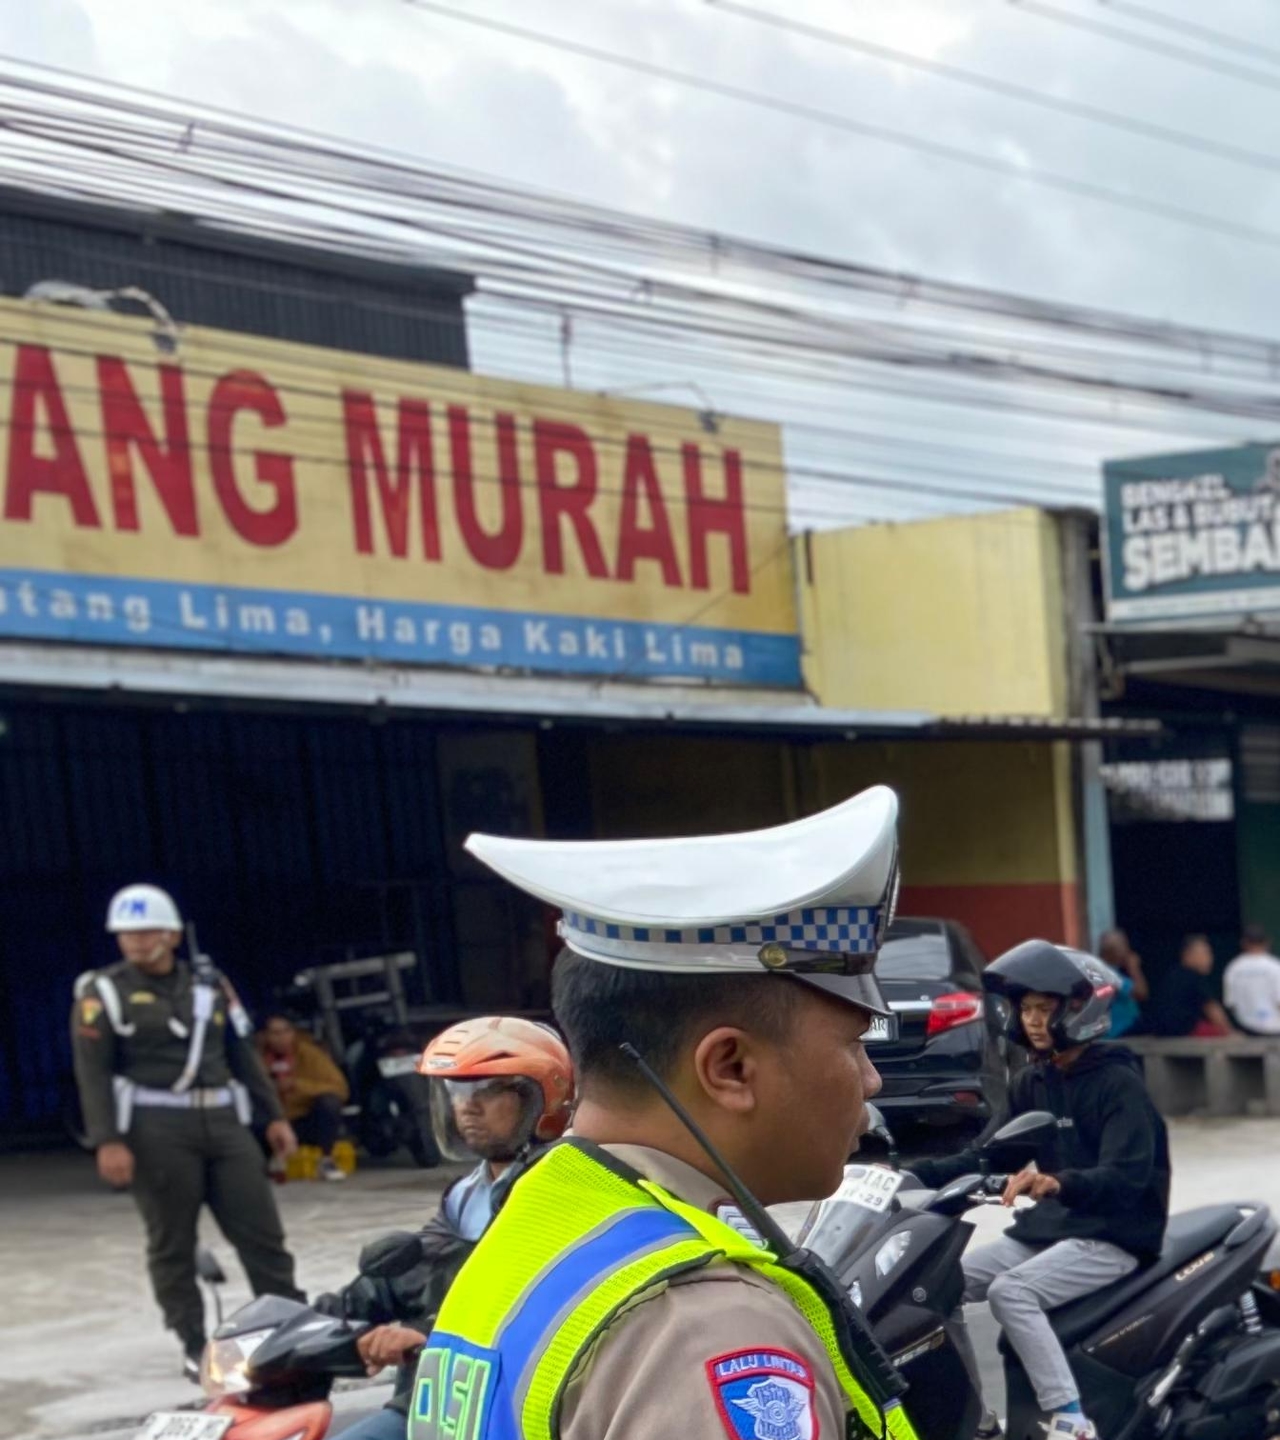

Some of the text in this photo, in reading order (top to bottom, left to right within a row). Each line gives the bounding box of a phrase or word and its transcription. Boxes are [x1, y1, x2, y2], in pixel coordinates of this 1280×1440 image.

[340, 386, 752, 596] MURAH
[180, 591, 332, 644] Lima,
[356, 607, 501, 655] Harga
[524, 620, 625, 659] Kaki
[645, 632, 745, 669] Lima
